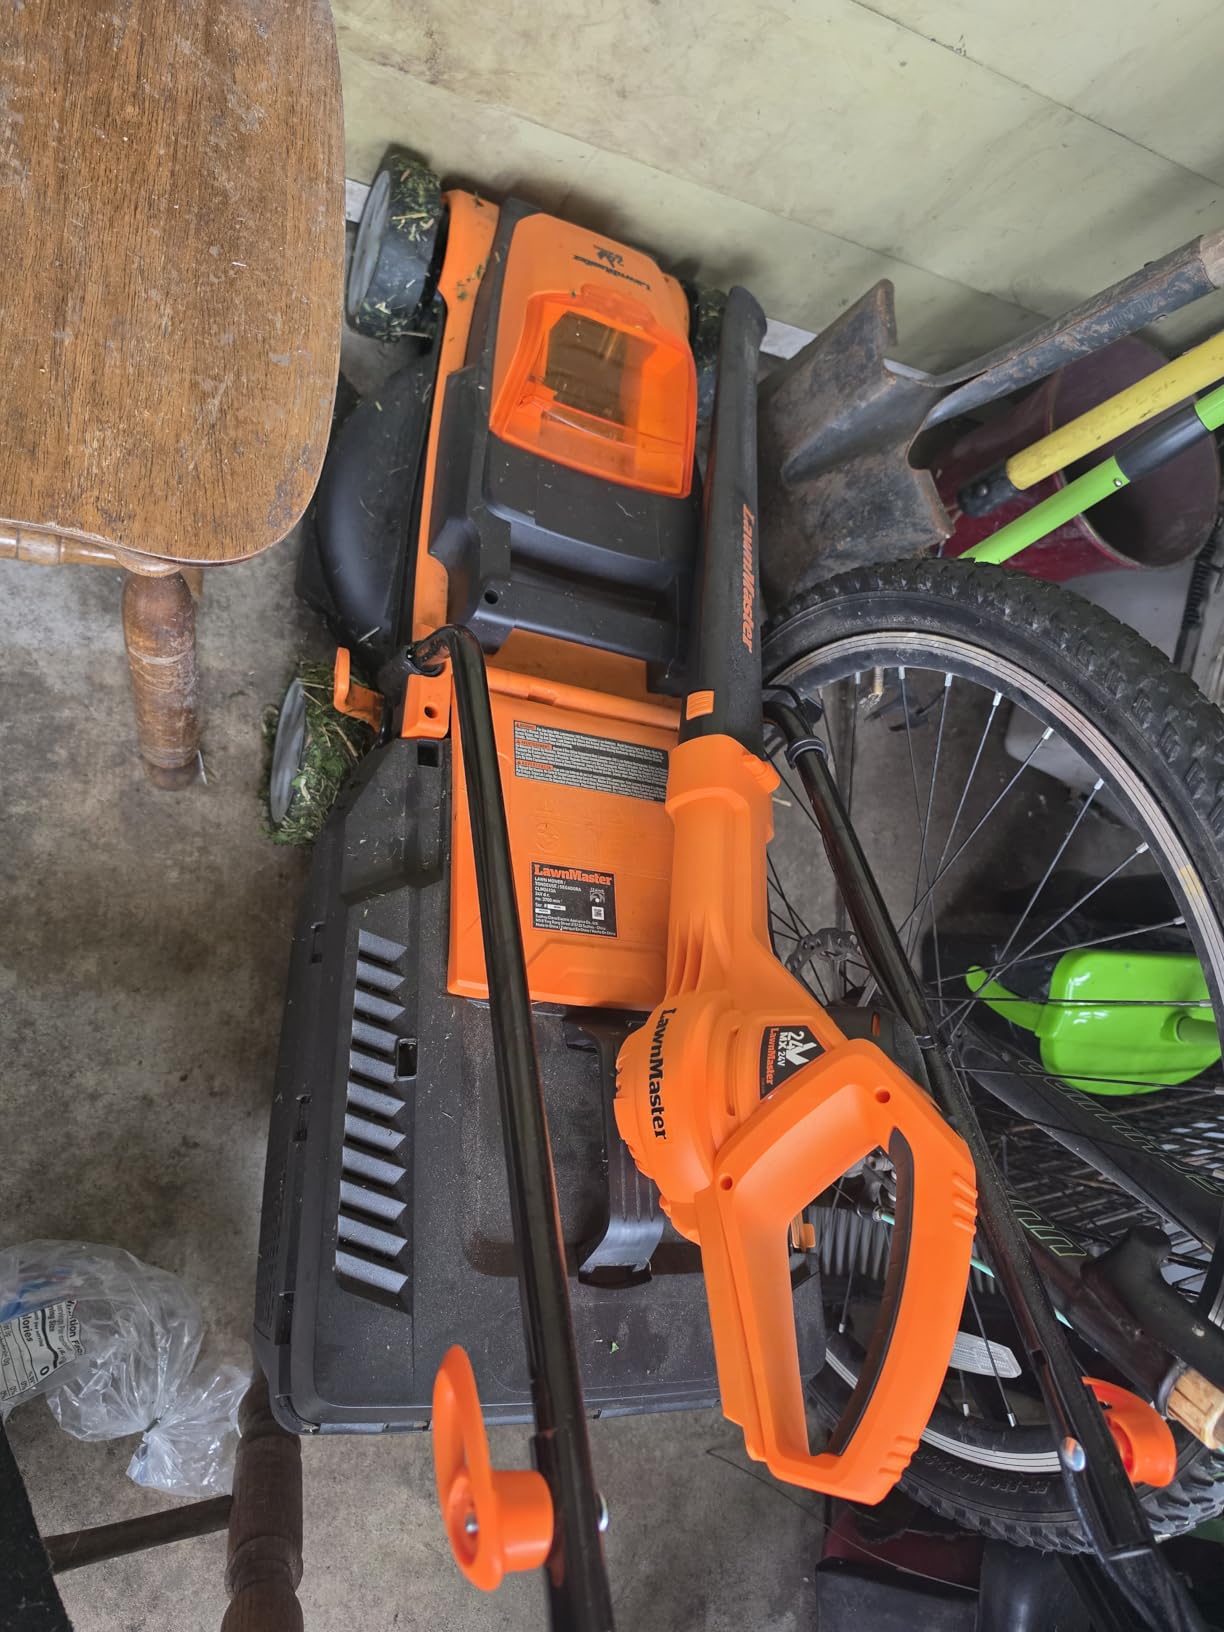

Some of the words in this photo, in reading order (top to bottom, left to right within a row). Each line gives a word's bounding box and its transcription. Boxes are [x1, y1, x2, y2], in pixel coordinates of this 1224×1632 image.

[742, 503, 756, 655] LawnMaster
[533, 863, 613, 886] LawnMaster
[765, 1027, 780, 1086] LawnMaster
[776, 1051, 787, 1067] 24V
[778, 1031, 788, 1050] MX
[648, 1007, 678, 1140] LawnMaster
